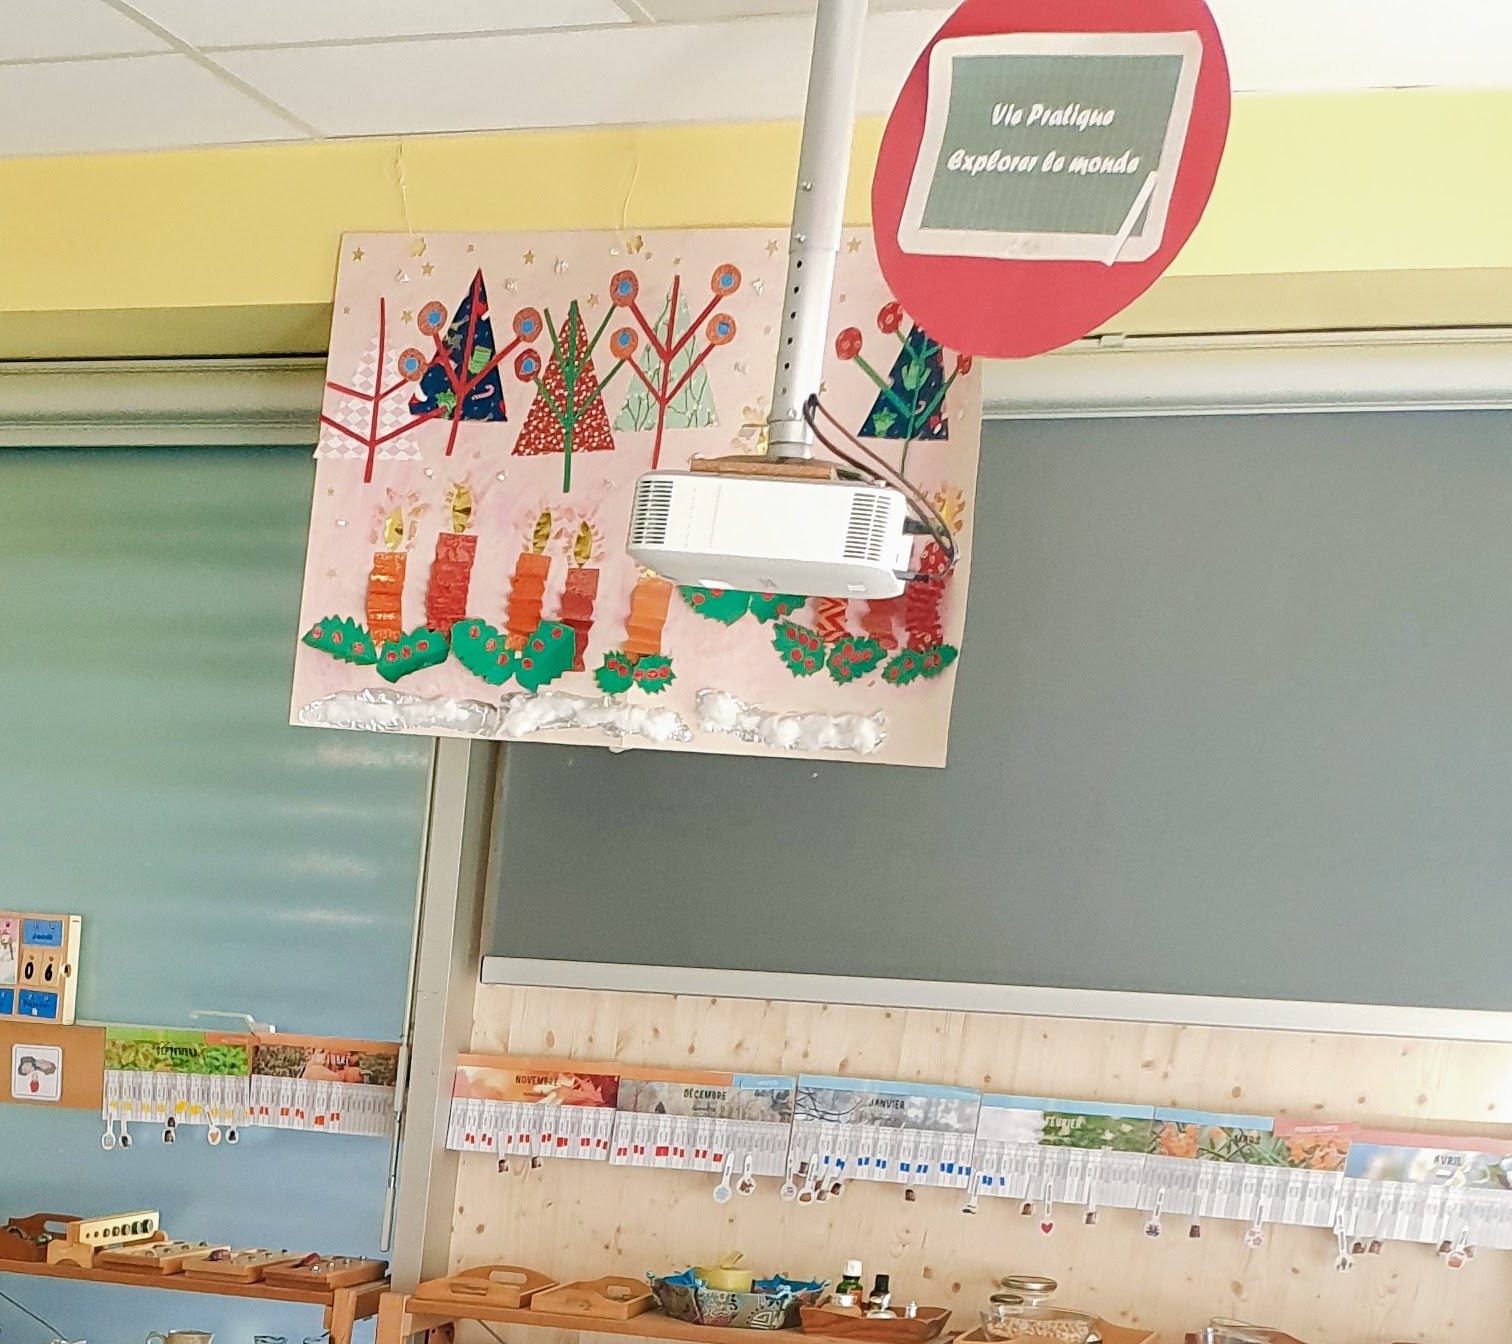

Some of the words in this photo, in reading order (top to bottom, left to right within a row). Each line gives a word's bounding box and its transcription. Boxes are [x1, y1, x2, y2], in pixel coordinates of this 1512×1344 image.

[991, 102, 1023, 127] Vie
[1026, 102, 1116, 131] Pratique
[947, 149, 1037, 175] Explorer
[1041, 149, 1065, 173] le
[1068, 149, 1141, 175] monde
[515, 1075, 558, 1087] NOVEMBRE
[868, 1097, 906, 1111] JANVIER
[1433, 1154, 1463, 1167] AVRIL
